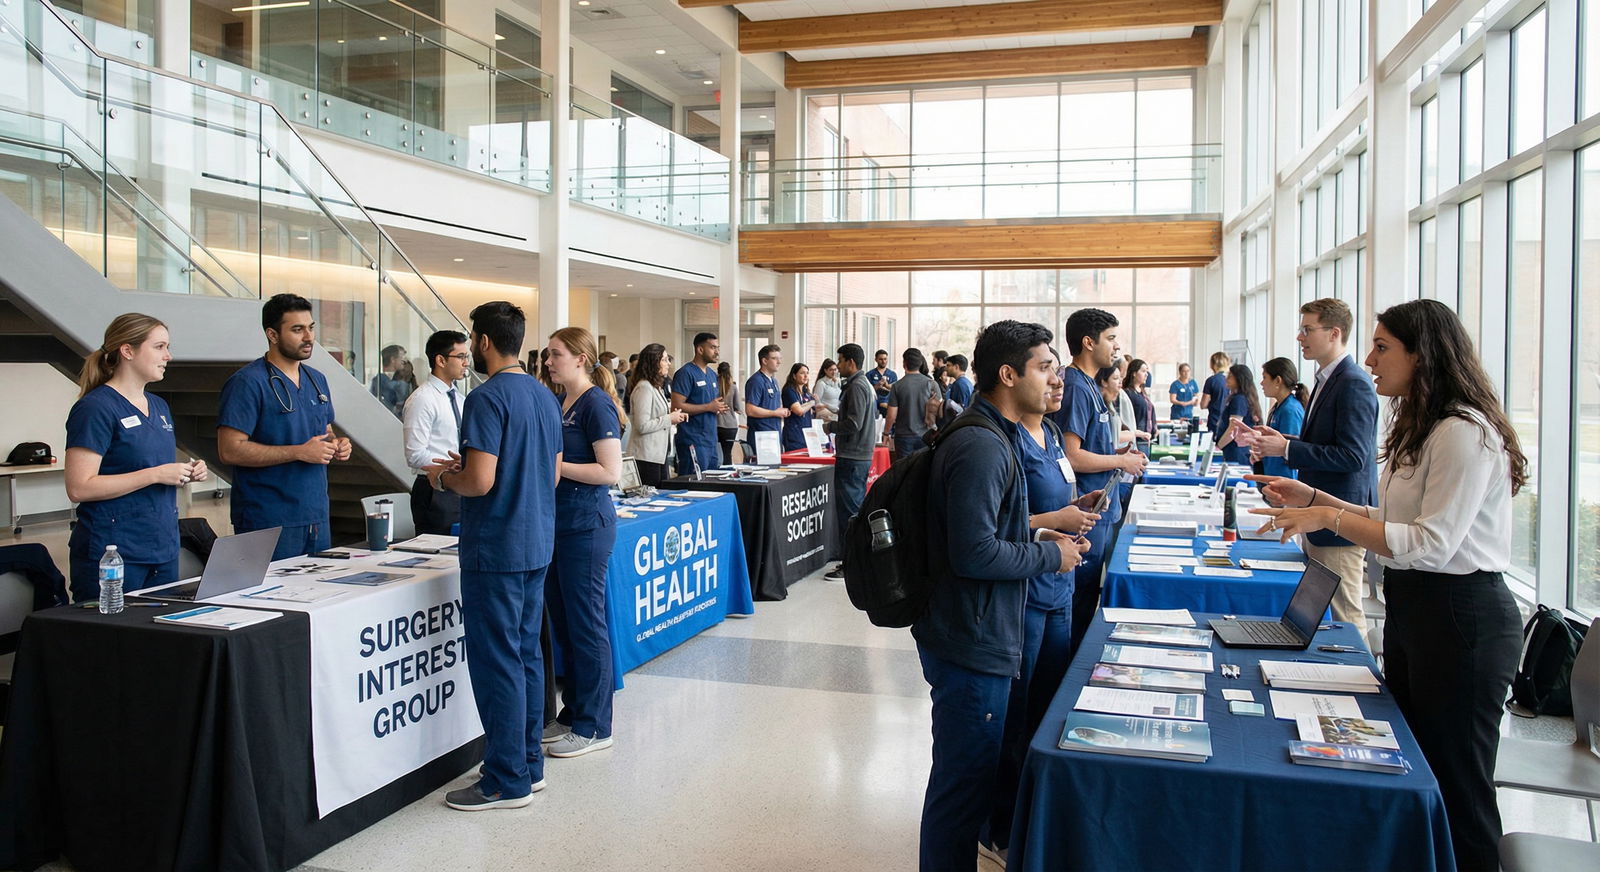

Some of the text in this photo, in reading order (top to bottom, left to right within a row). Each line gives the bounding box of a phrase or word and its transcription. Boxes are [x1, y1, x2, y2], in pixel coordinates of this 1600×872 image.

[782, 483, 829, 517] RESEARCH
[787, 509, 825, 543] SOCIETY
[634, 515, 718, 576] GLOBAL
[635, 553, 718, 626] HEALTH
[359, 599, 464, 658] SURGERY
[358, 635, 466, 704] INTEREST
[373, 680, 455, 739] GROUP
